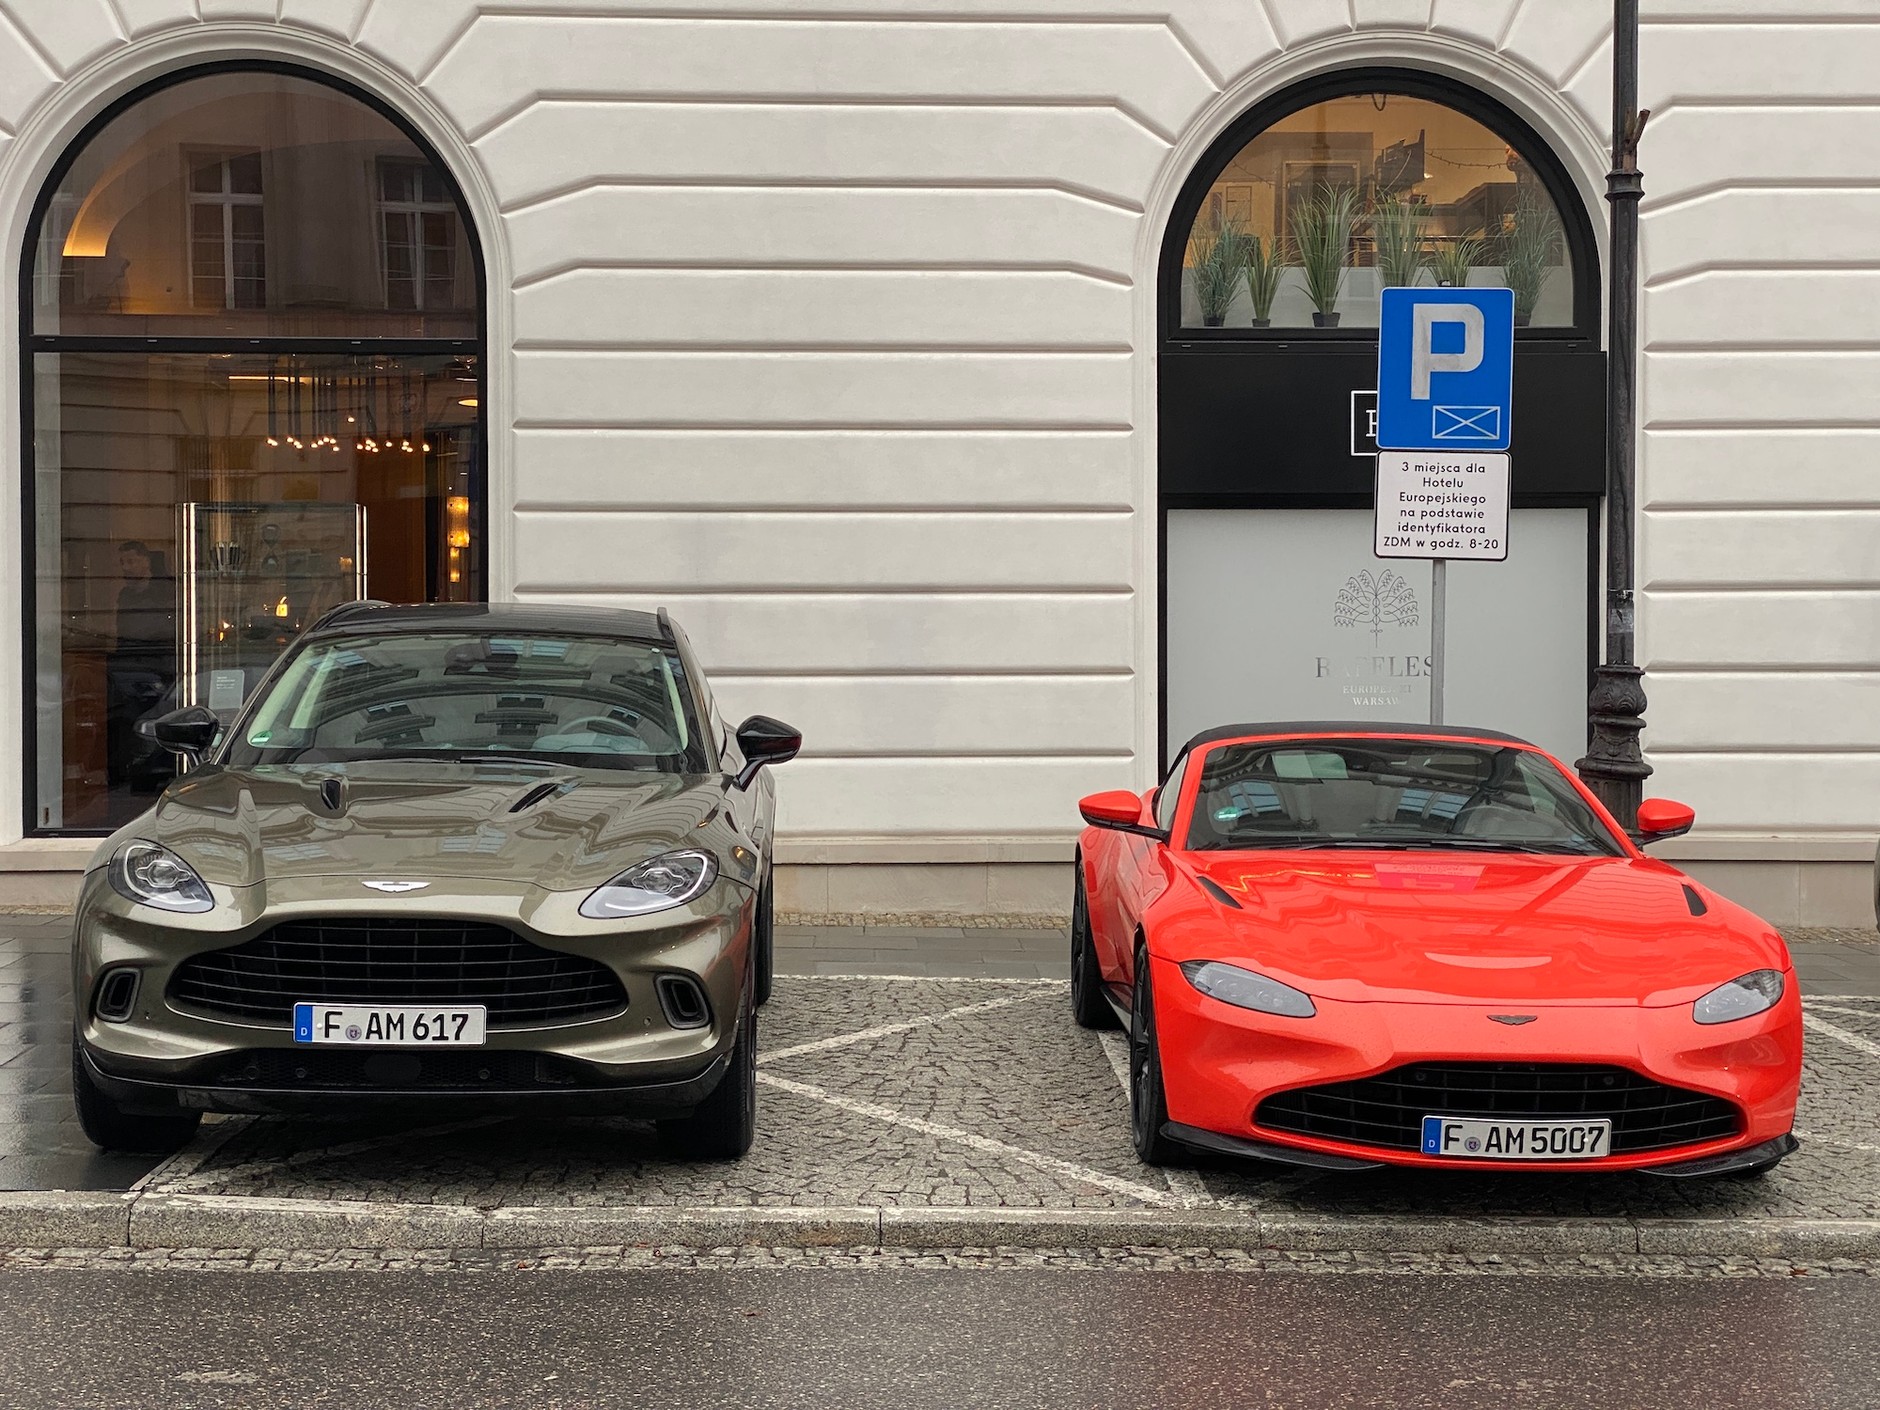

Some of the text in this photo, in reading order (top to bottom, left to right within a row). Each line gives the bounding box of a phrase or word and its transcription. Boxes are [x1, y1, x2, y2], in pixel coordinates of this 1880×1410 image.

[1410, 303, 1485, 400] P
[1401, 461, 1486, 476] 3 miejsca dla
[1422, 477, 1464, 488] Hotelu
[1399, 491, 1487, 507] Europejskiego
[1400, 507, 1485, 521] na podstawie
[1397, 521, 1486, 536] identyfikatora
[1383, 536, 1499, 551] ZDM w godz. 8-20
[1315, 656, 1432, 678] RFLES
[1343, 684, 1412, 694] EUROPEI
[1353, 697, 1400, 706] WARSAW
[324, 1011, 343, 1038] F
[1444, 1125, 1463, 1150] F
